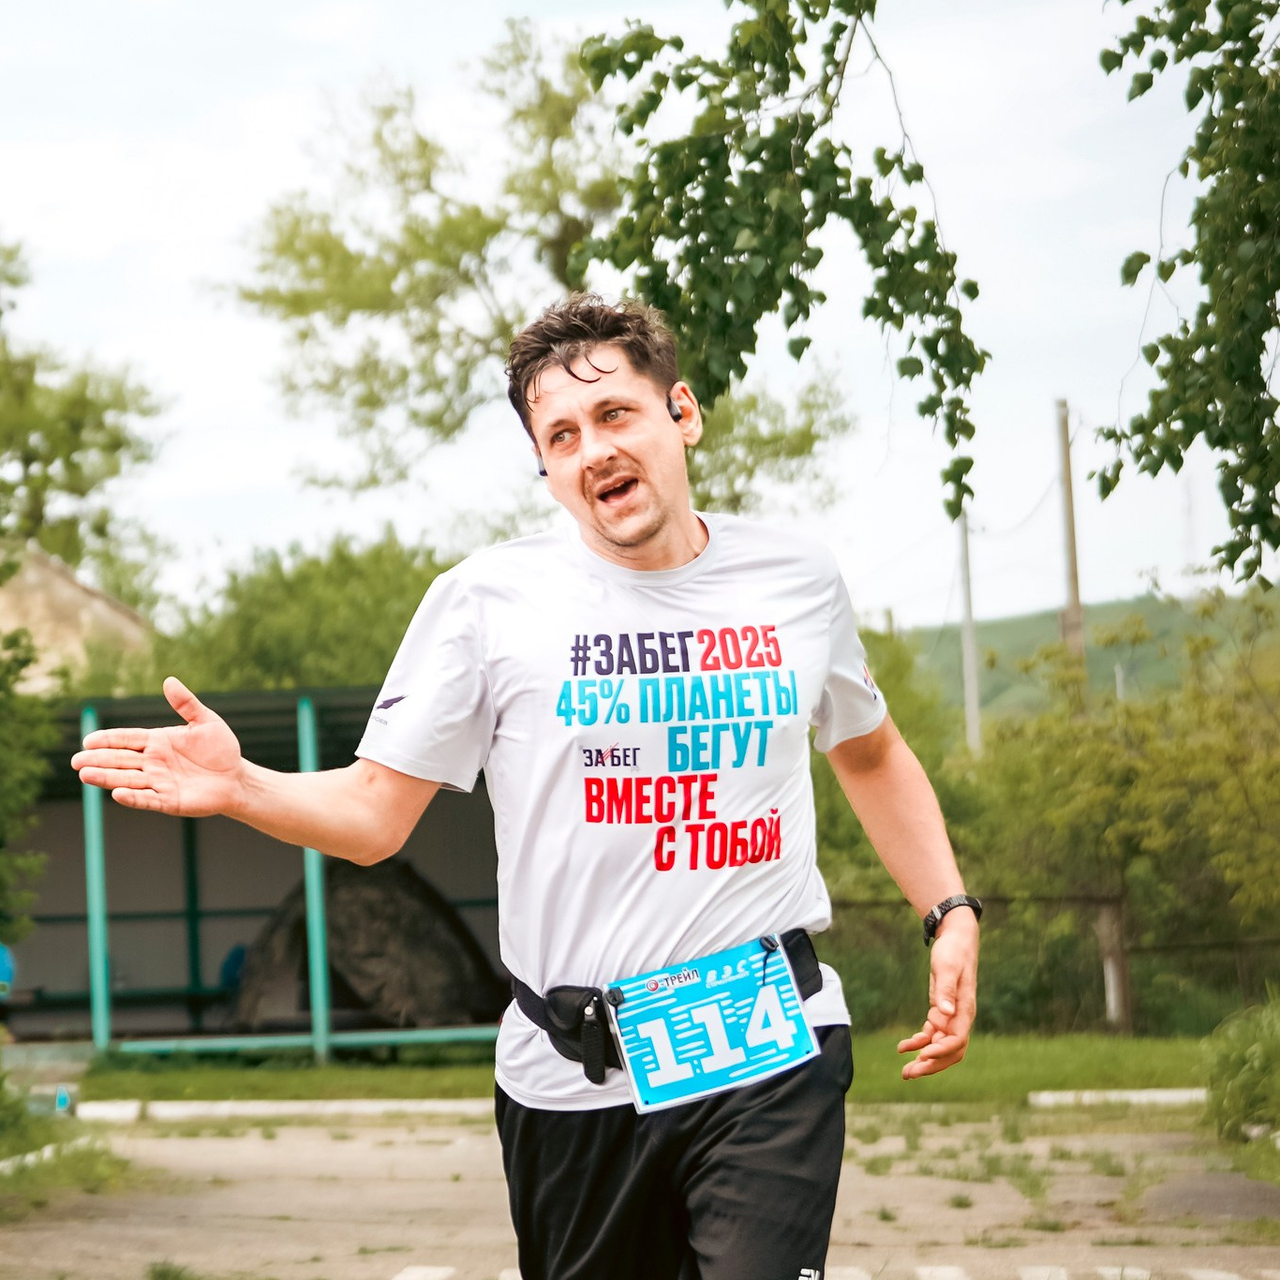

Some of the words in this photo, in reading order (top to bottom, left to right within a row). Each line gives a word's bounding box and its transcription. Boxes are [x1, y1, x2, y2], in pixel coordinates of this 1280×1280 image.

[556, 679, 630, 726] 45%
[638, 670, 798, 723] ПЛАНЕТЫ
[668, 720, 773, 772] БЕГУТ
[584, 773, 718, 824] ВМЕСТЕ
[654, 826, 676, 871] С
[685, 808, 782, 870] ТОБОЙ
[637, 983, 798, 1088] 114
